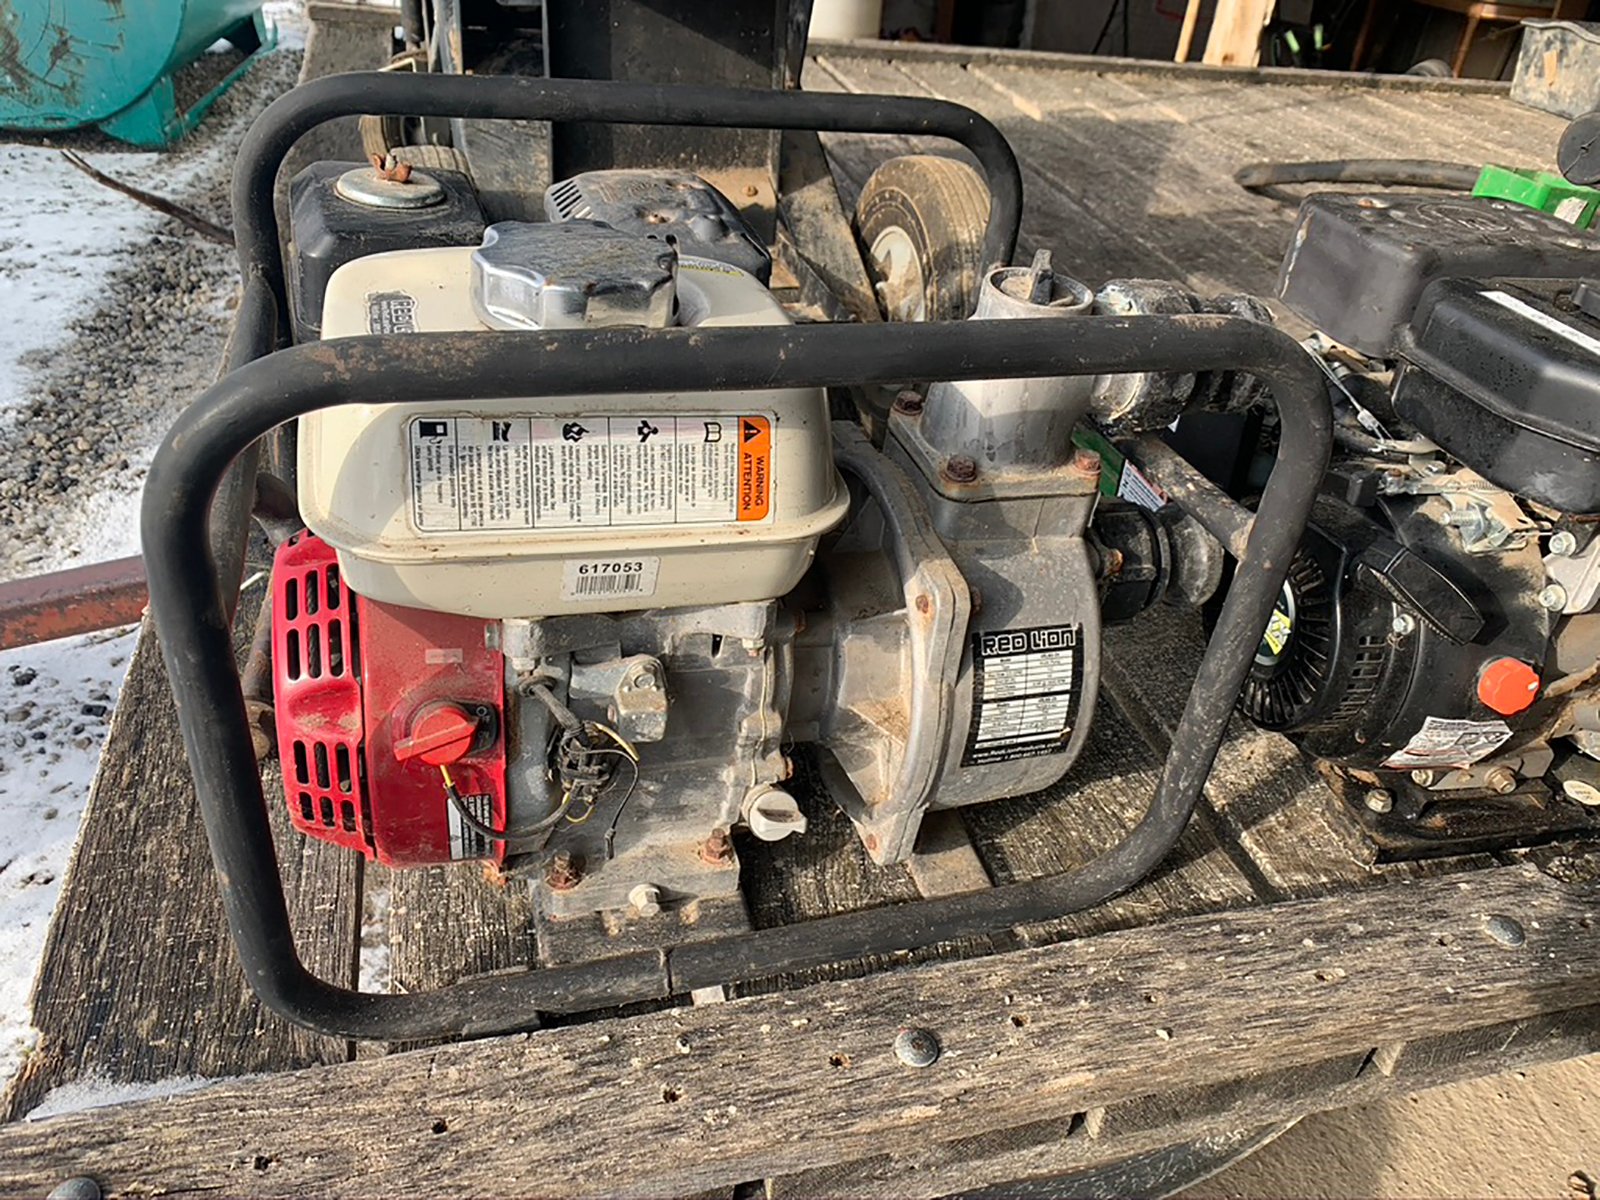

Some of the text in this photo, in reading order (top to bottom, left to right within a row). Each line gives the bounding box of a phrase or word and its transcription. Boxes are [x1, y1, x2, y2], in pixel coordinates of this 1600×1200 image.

[743, 452, 752, 510] ATTENTION
[755, 456, 765, 507] WARNING
[579, 562, 643, 575] 617053
